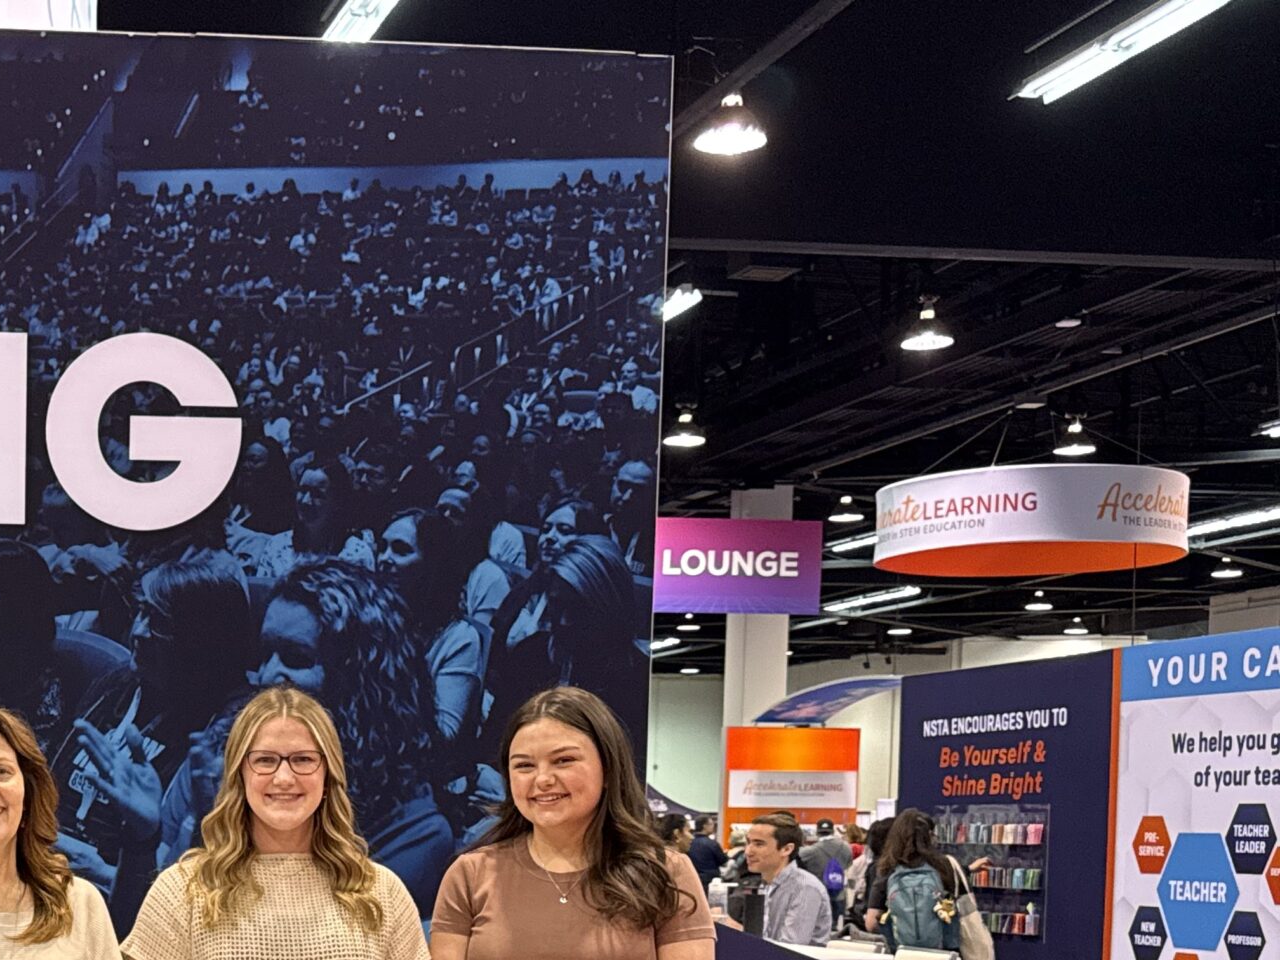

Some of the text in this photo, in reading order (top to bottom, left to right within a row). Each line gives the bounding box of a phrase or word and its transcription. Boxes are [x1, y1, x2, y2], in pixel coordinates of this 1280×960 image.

[923, 518, 986, 534] EDUCATION
[1122, 515, 1141, 527] THE
[1143, 517, 1172, 529] LEADER
[661, 548, 800, 577] LOUNGE
[1147, 645, 1280, 687] YOUR CA
[922, 707, 1069, 738] NSTA ENCOURAGES YOU TO
[1171, 732, 1195, 754] We
[1198, 730, 1233, 758] help
[1236, 733, 1267, 757] you
[939, 740, 1047, 768] Be Yourself &
[942, 770, 1044, 801] Shine Bright
[1193, 765, 1280, 793] of your tea
[1144, 831, 1160, 843] PRE-
[1232, 824, 1270, 838] TEACHER
[1138, 845, 1165, 857] SERVICE
[1234, 840, 1267, 854] LEADER
[1168, 879, 1228, 904] TEACHER
[1140, 921, 1156, 932] NEW
[1133, 934, 1162, 947] TEACHER
[1227, 934, 1262, 947] PROFESSOR
